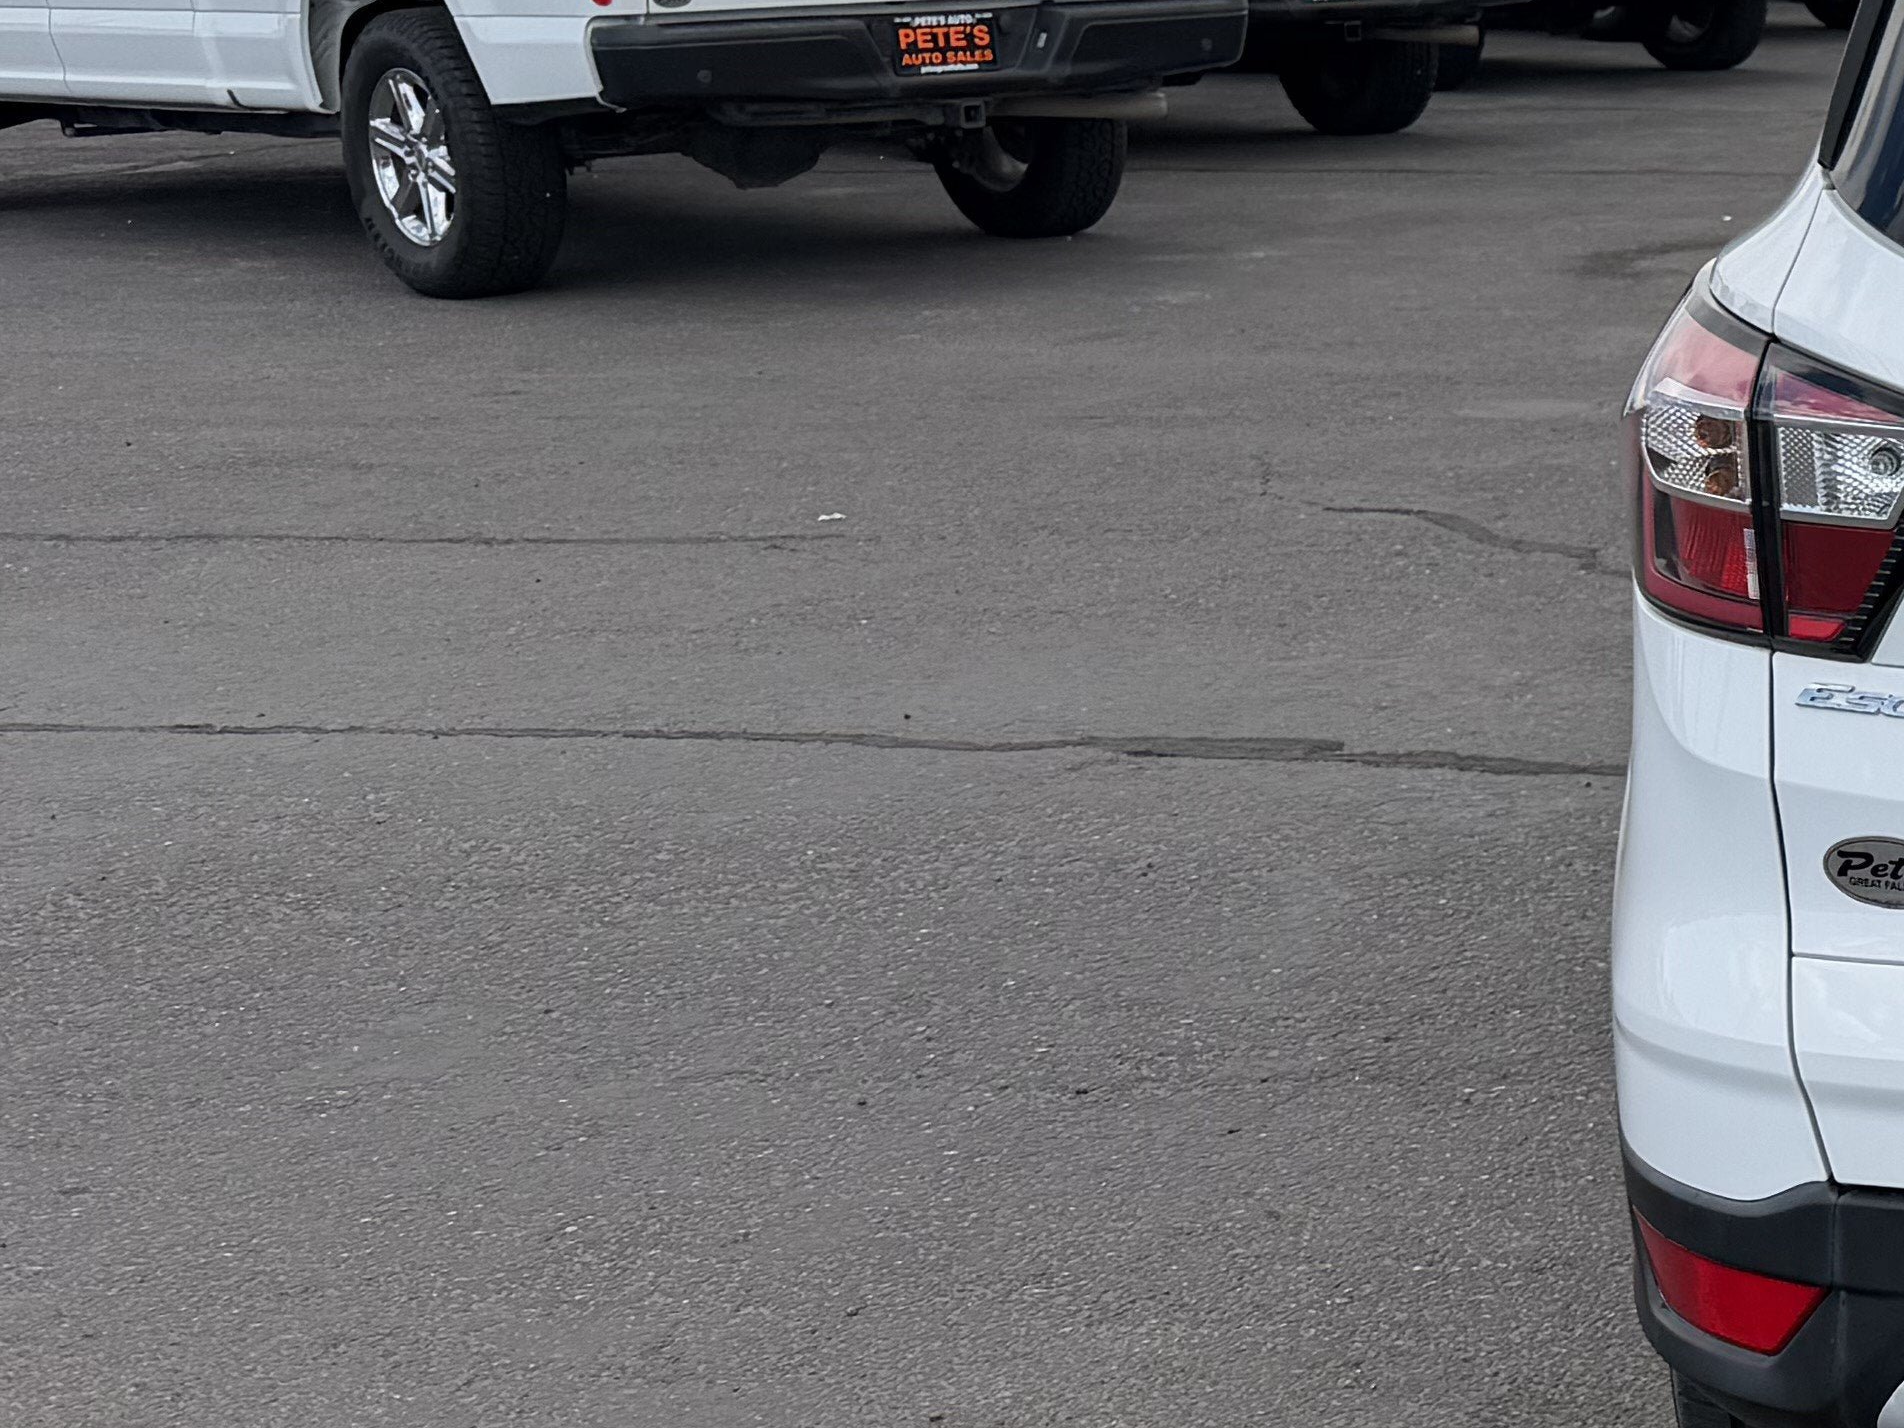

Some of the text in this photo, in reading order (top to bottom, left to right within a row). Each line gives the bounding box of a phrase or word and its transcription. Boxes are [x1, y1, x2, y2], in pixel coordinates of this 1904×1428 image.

[898, 25, 991, 50] PETE'S
[901, 49, 994, 66] AUTO SALES
